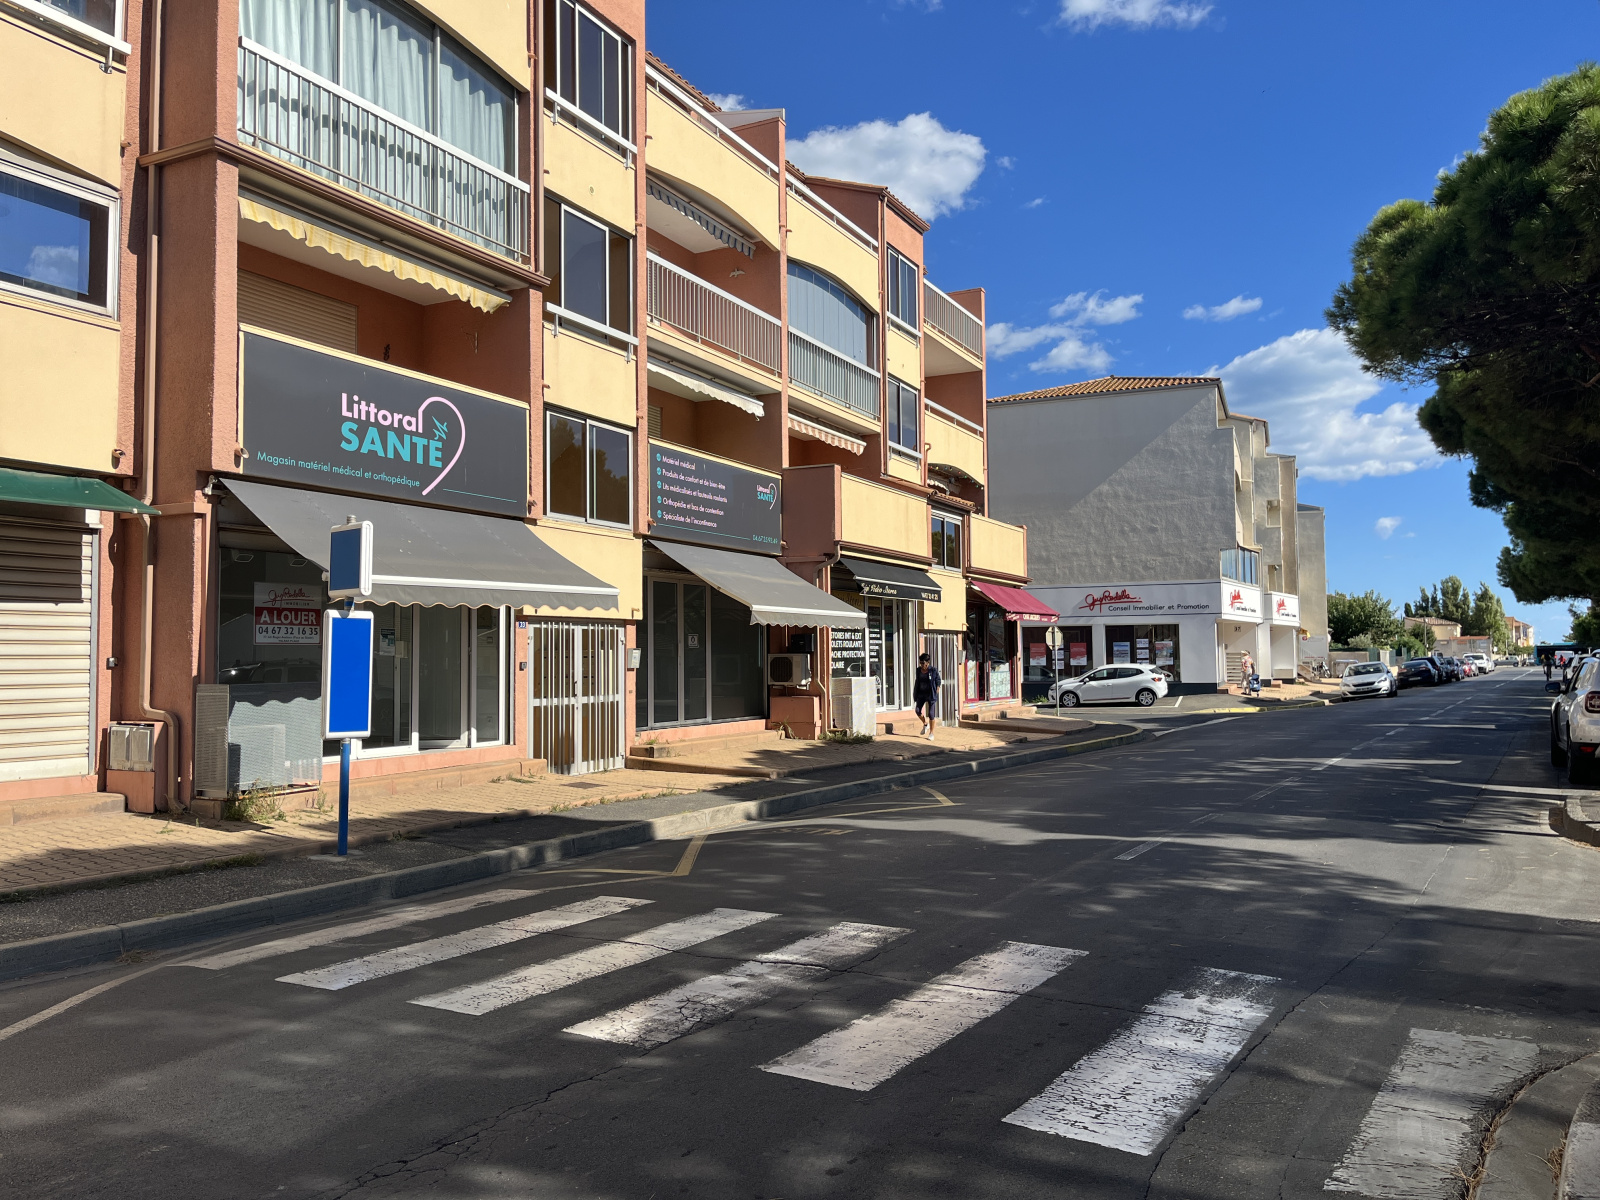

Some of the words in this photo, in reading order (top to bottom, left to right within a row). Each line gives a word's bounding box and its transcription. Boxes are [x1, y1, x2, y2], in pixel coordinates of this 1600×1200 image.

[341, 392, 423, 433] Littoral
[257, 451, 296, 466] Magasin
[298, 460, 331, 472] matériel
[333, 465, 363, 478] médical
[364, 471, 372, 479] et
[373, 472, 420, 487] orthopédique
[662, 455, 680, 466] Matériel
[680, 461, 696, 470] médical
[662, 468, 679, 479] Produits
[679, 473, 685, 481] de
[685, 475, 699, 484] confort
[670, 484, 693, 496] médicalisés
[662, 497, 687, 509] Orthopédie
[691, 503, 699, 511] bas
[705, 507, 724, 516] contention
[662, 511, 685, 522] Spécialiste
[260, 610, 270, 624] A
[273, 611, 317, 625] LOUER
[258, 626, 269, 635] 04
[271, 627, 281, 635] 67
[284, 627, 294, 635] 32
[297, 627, 306, 635] 16
[309, 627, 318, 636] 35
[831, 640, 843, 648] OLETS
[843, 640, 863, 648] ROULANTS
[842, 650, 865, 658] PROTECTION
[831, 661, 845, 669] OLAIRE
